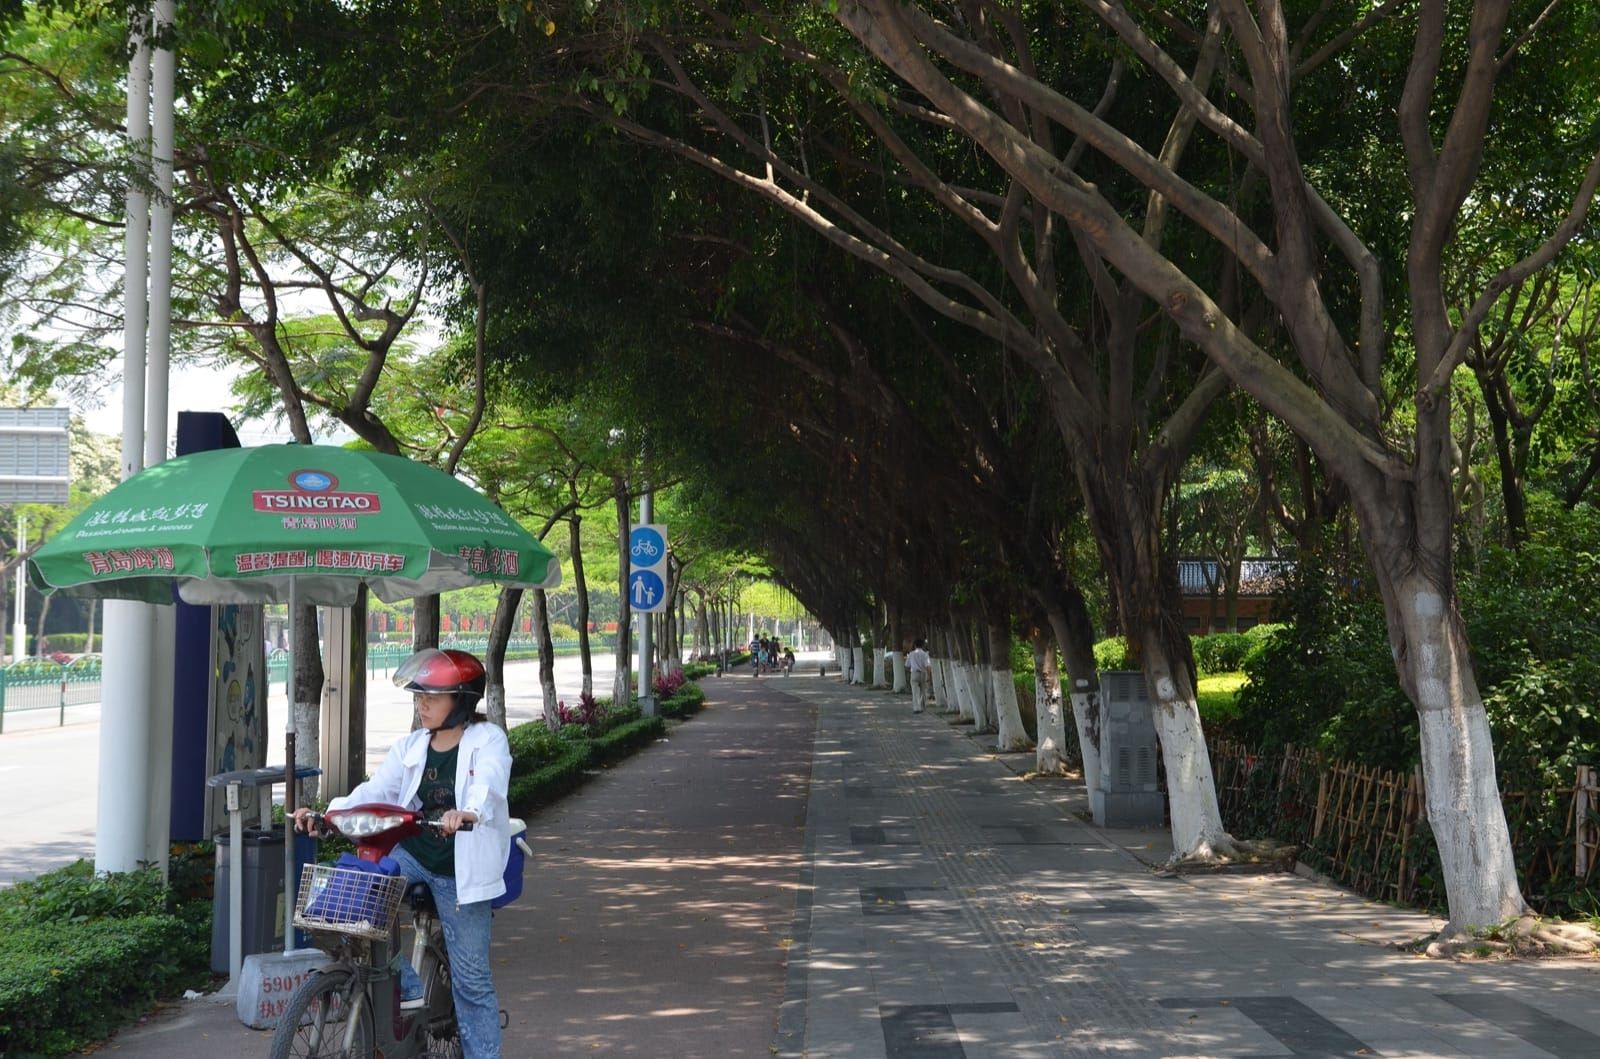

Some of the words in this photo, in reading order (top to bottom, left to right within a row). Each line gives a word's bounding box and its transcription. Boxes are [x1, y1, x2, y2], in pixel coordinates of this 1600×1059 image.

[262, 495, 370, 508] TSINGTAO
[281, 516, 357, 529] 青岛啤酒
[82, 547, 175, 575] 青岛啤酒
